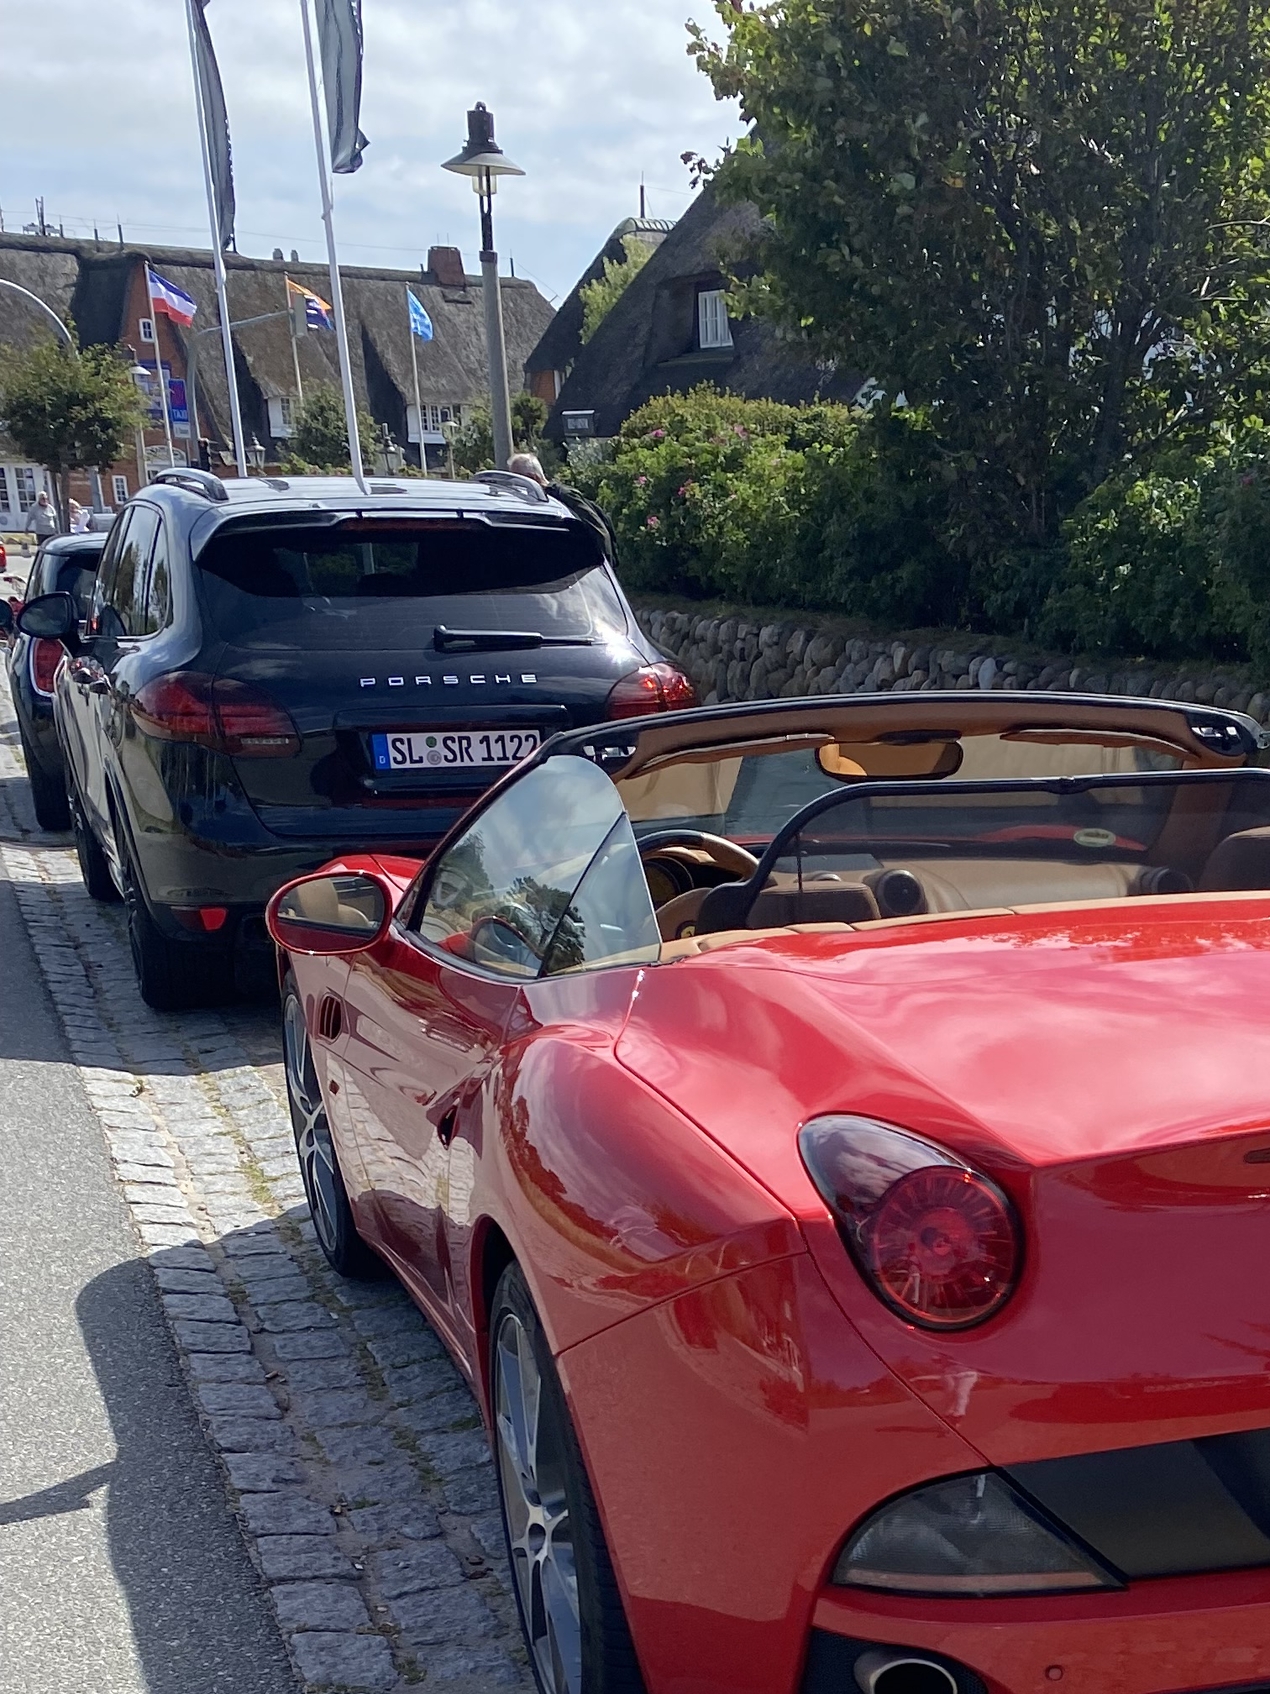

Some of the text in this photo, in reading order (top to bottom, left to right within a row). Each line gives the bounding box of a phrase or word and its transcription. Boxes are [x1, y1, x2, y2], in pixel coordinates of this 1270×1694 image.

[360, 673, 538, 688] PORSCHE
[391, 737, 424, 765] SL
[442, 735, 475, 764] SR
[479, 733, 538, 763] 1122
